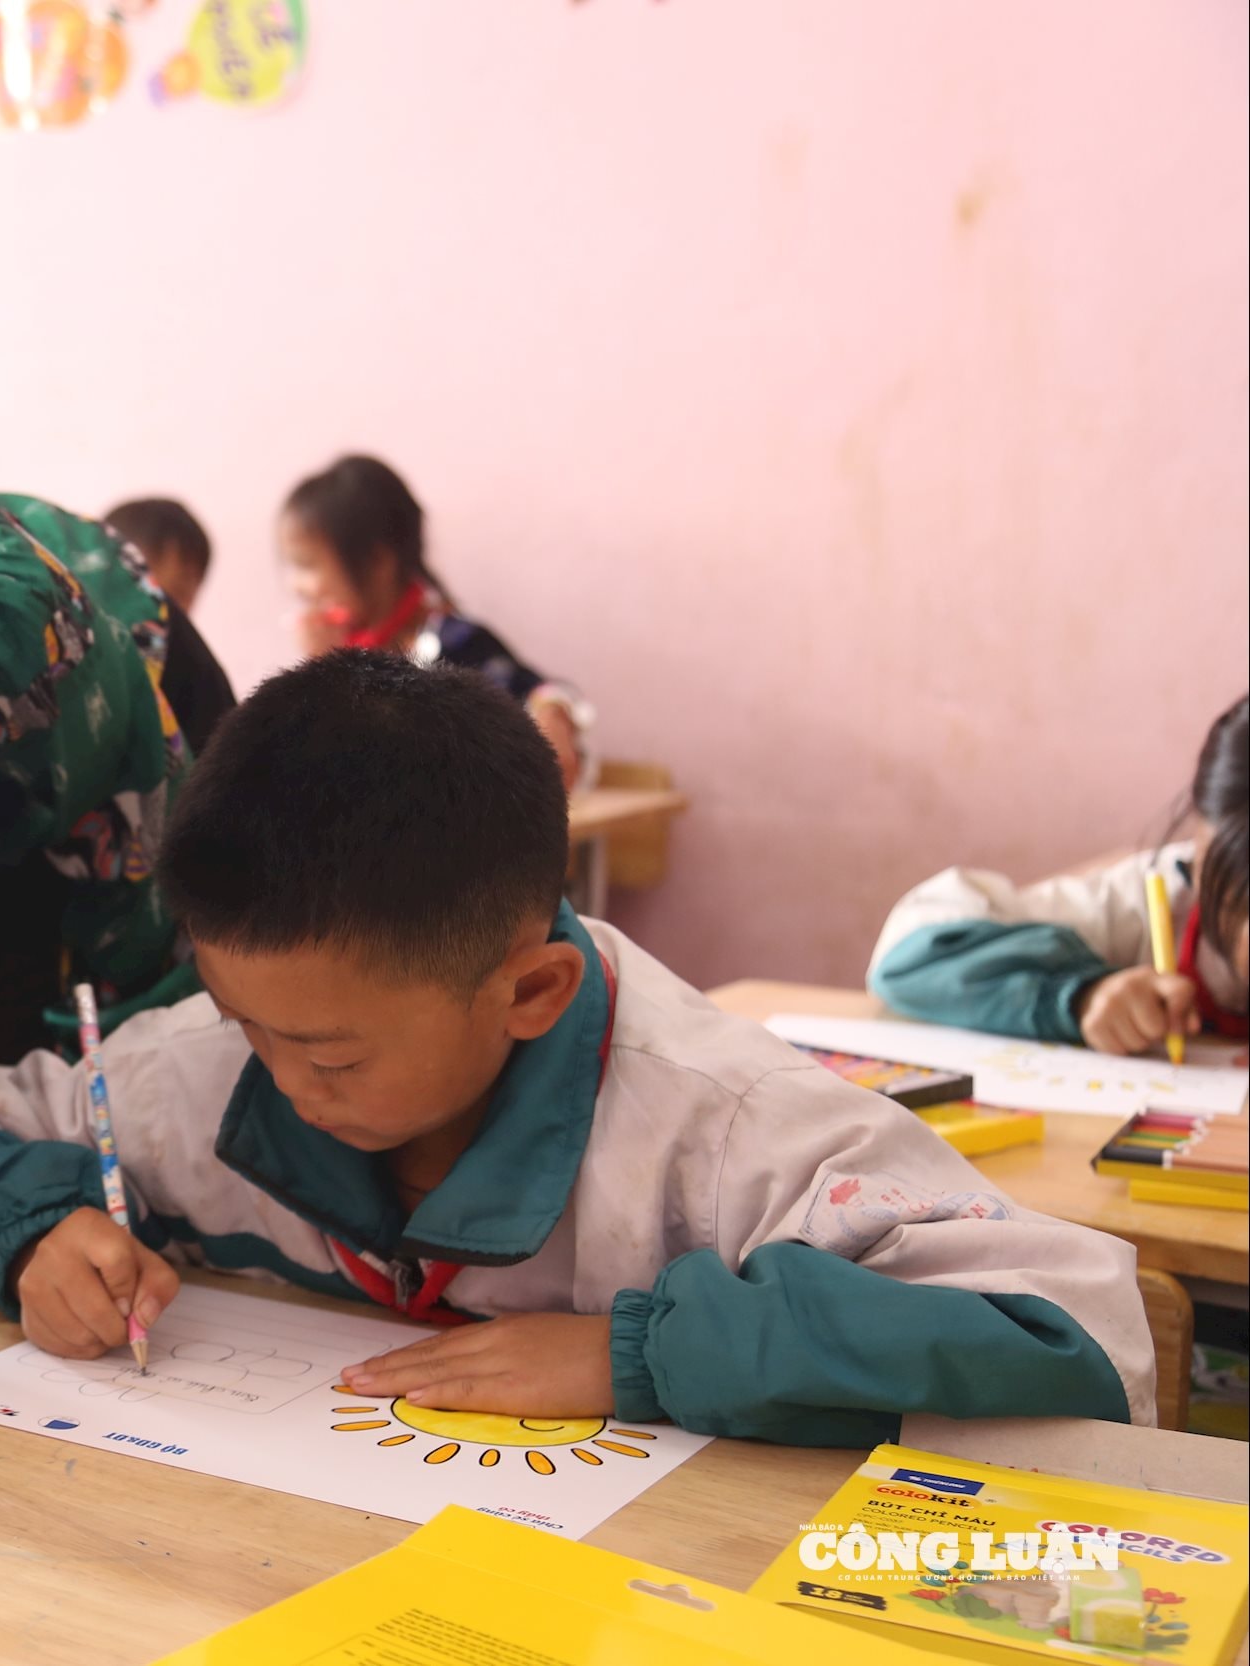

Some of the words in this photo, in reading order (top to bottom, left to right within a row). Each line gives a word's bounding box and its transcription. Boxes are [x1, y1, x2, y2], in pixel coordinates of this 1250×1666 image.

[867, 1498, 907, 1510] BÚT
[876, 1486, 972, 1507] colokit
[862, 1507, 927, 1522] COLORED
[930, 1518, 991, 1533] PENCILS
[810, 1586, 842, 1600] 18
